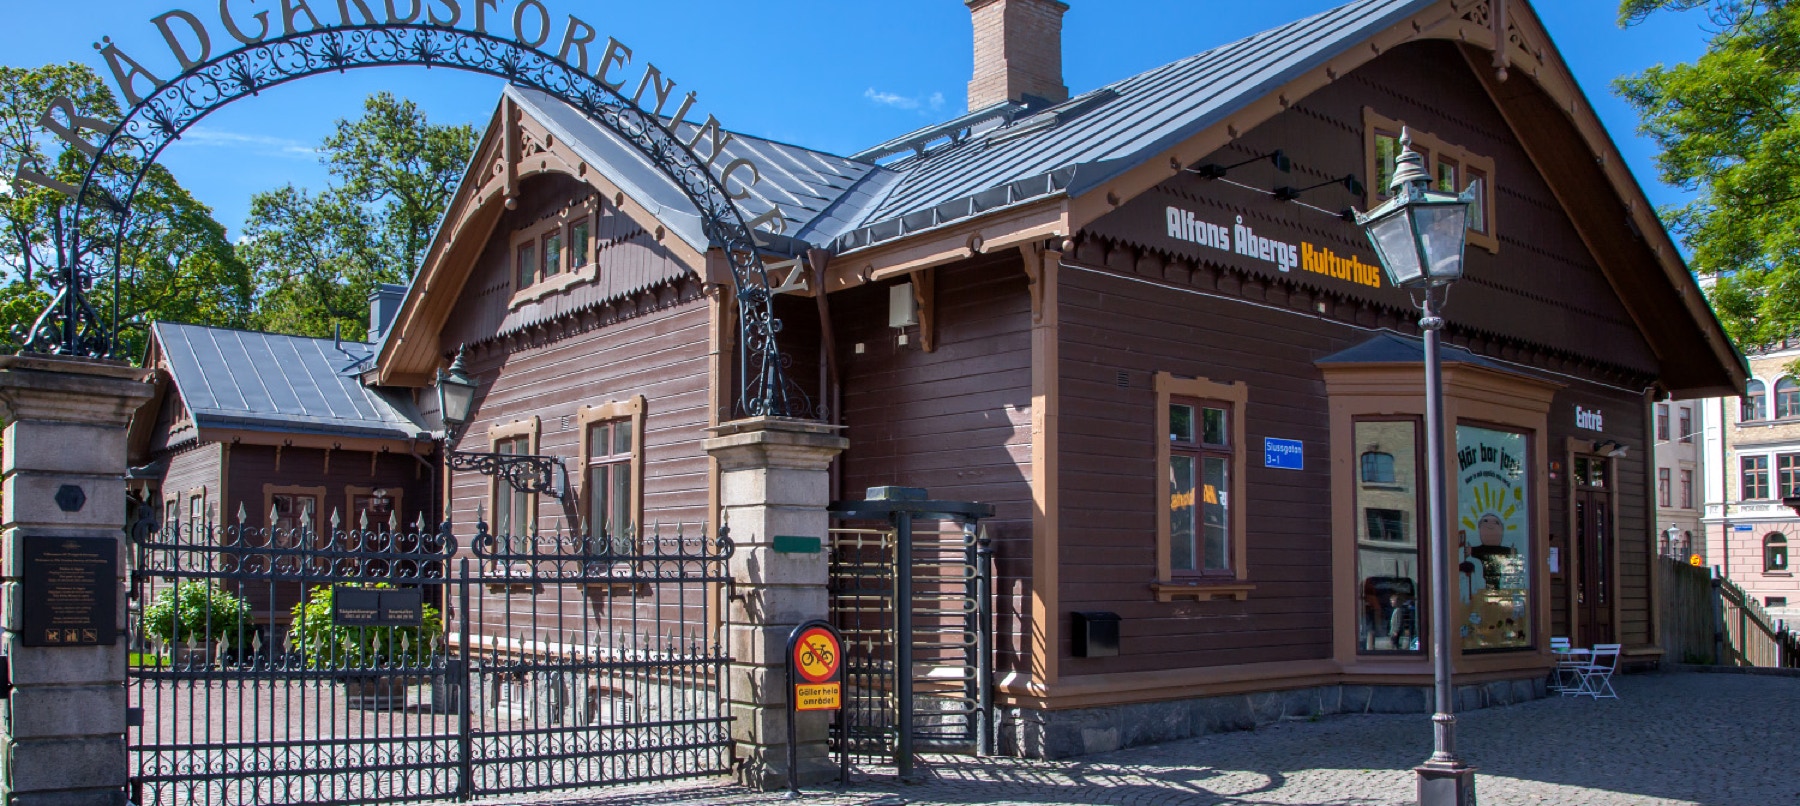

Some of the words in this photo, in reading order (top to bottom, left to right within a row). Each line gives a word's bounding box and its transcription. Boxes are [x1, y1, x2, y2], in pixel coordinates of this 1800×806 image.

[1166, 206, 1230, 251] Alfons
[1234, 215, 1298, 273] Åbergs
[1301, 241, 1381, 288] Kulturhus
[1575, 405, 1603, 432] Entré
[1266, 442, 1302, 455] Slussgatan
[1266, 454, 1280, 465] 3-1
[1458, 445, 1477, 472] Här
[1480, 442, 1498, 463] bor
[799, 687, 821, 696] Gäller
[823, 686, 838, 694] hela
[803, 697, 833, 705] området
